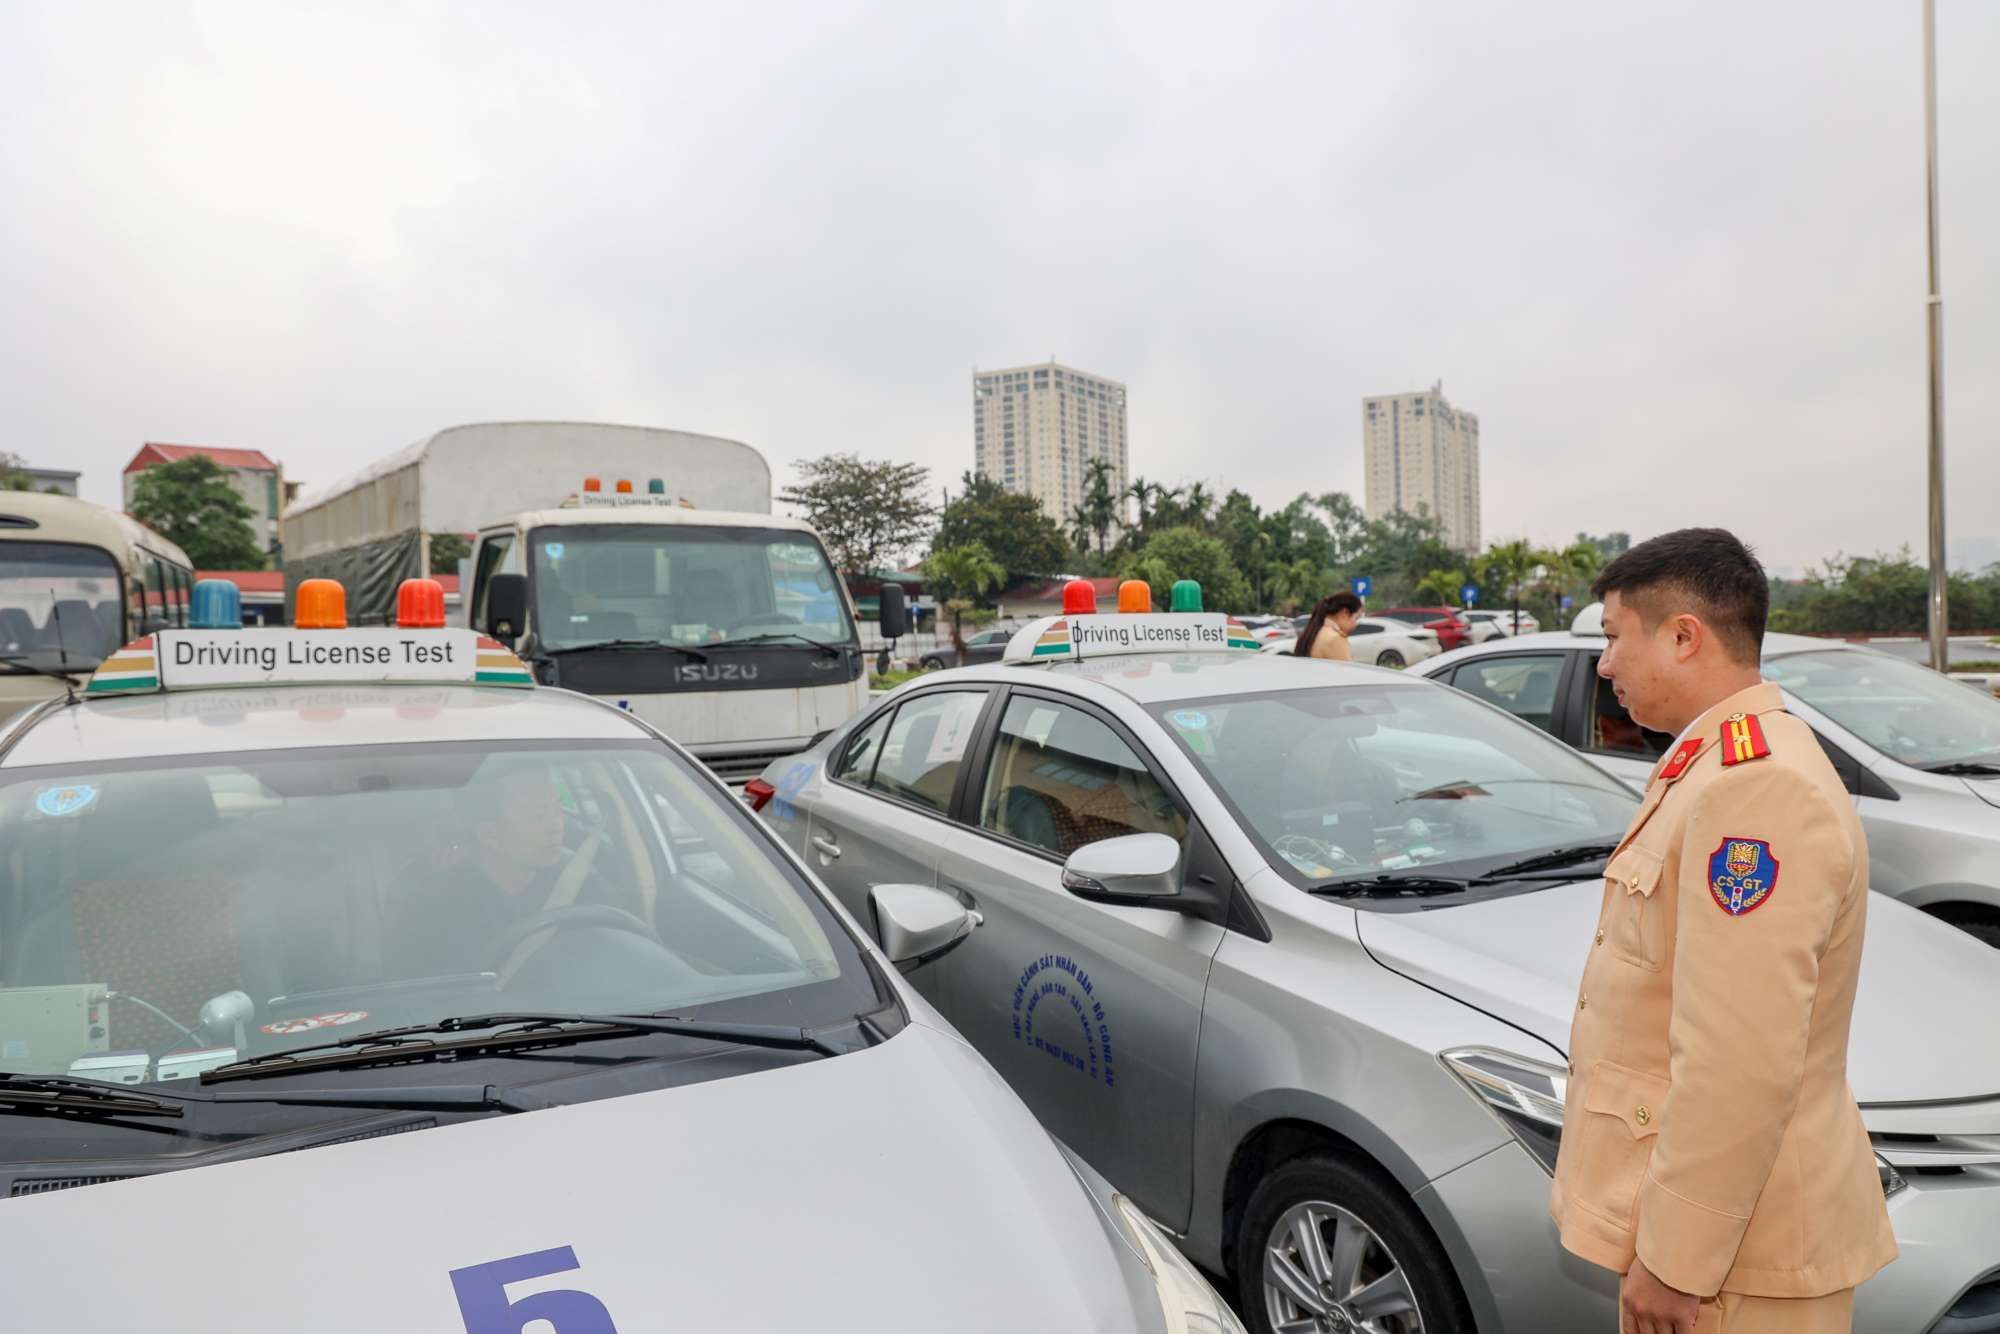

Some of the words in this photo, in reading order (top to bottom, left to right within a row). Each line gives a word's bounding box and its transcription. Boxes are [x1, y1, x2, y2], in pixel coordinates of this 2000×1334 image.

[1072, 624, 1129, 646] Driving
[1133, 624, 1190, 642] License
[1194, 624, 1224, 642] Test
[175, 641, 276, 671] Driving
[288, 640, 391, 664] License
[400, 640, 453, 663] Test
[674, 664, 758, 683] ISUZU
[448, 1245, 619, 1334] 5
